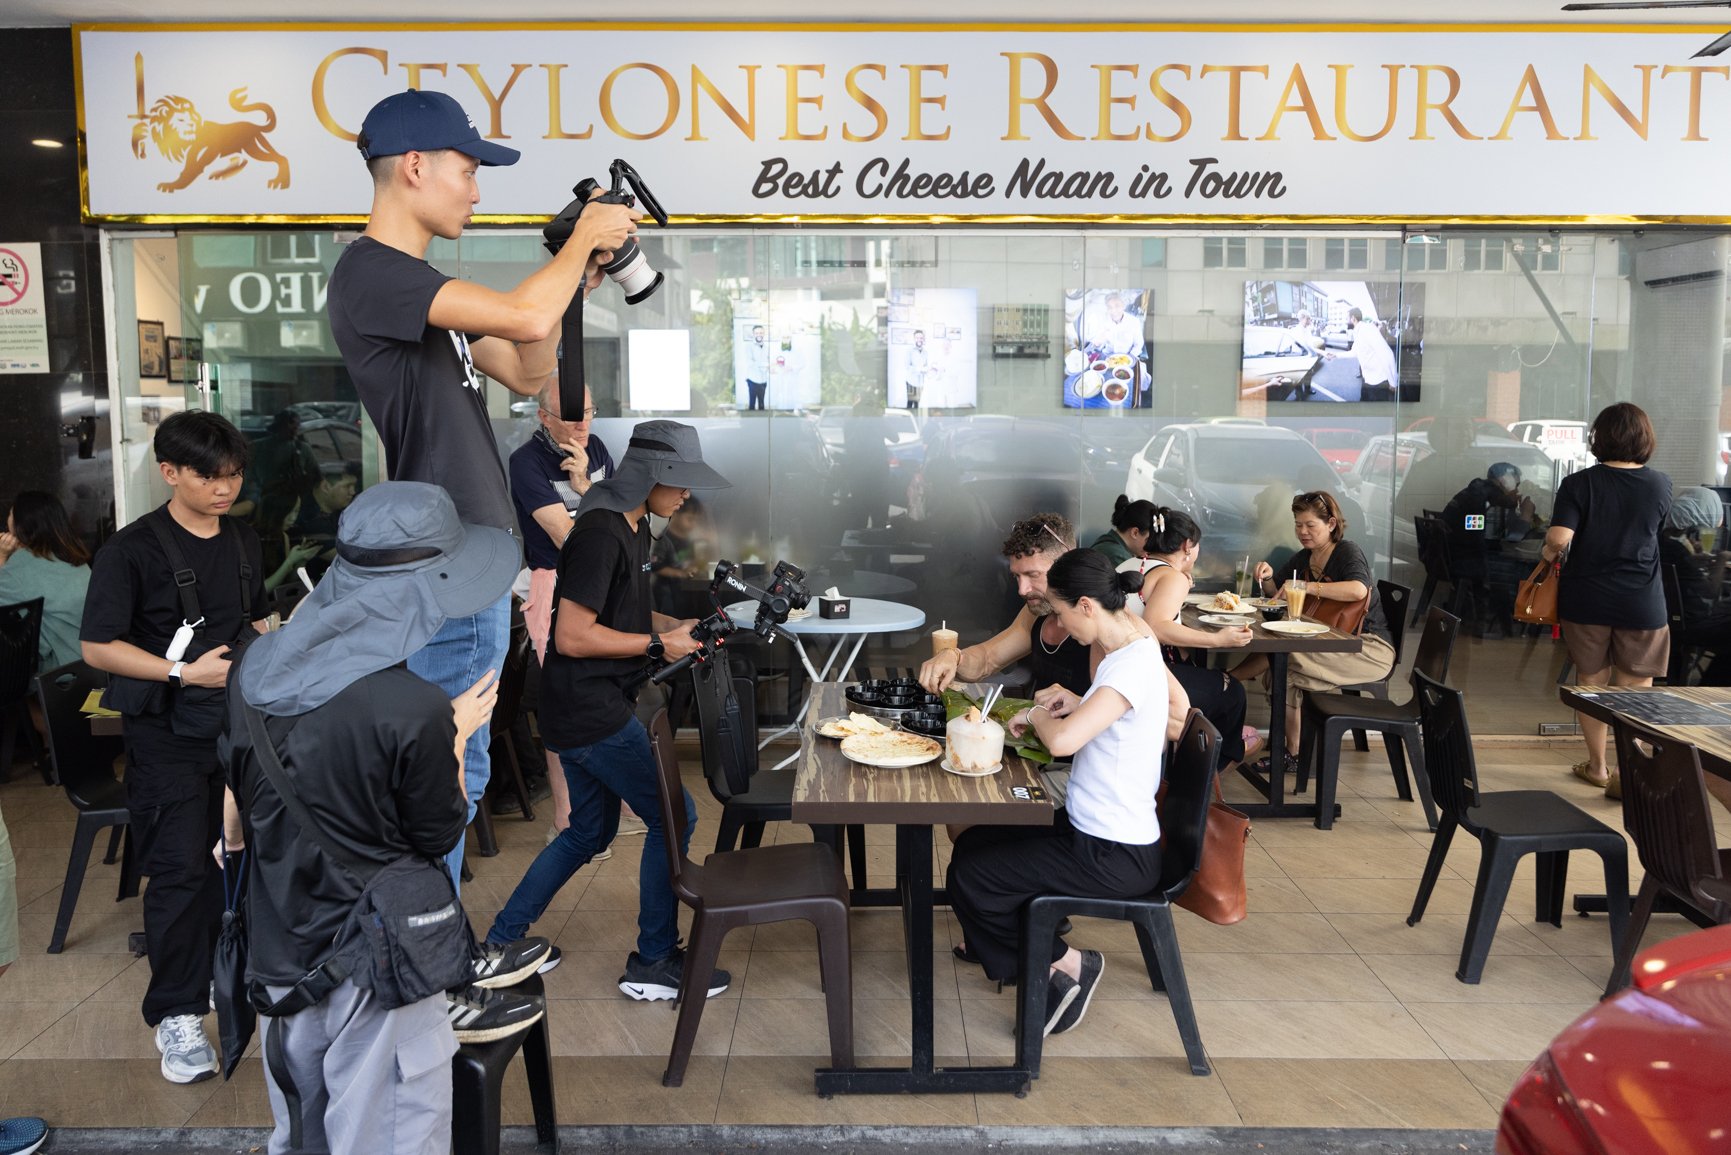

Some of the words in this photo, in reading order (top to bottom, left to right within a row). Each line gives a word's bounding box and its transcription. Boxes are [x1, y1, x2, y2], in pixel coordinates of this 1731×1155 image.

[1001, 52, 1730, 142] RESTAURANT
[752, 158, 843, 198] Best
[856, 158, 995, 198] Cheese
[1005, 158, 1118, 198] Naan
[1129, 165, 1172, 198] in
[1185, 158, 1286, 198] Town
[1547, 429, 1577, 439] PULL
[726, 576, 748, 592] RONIN
